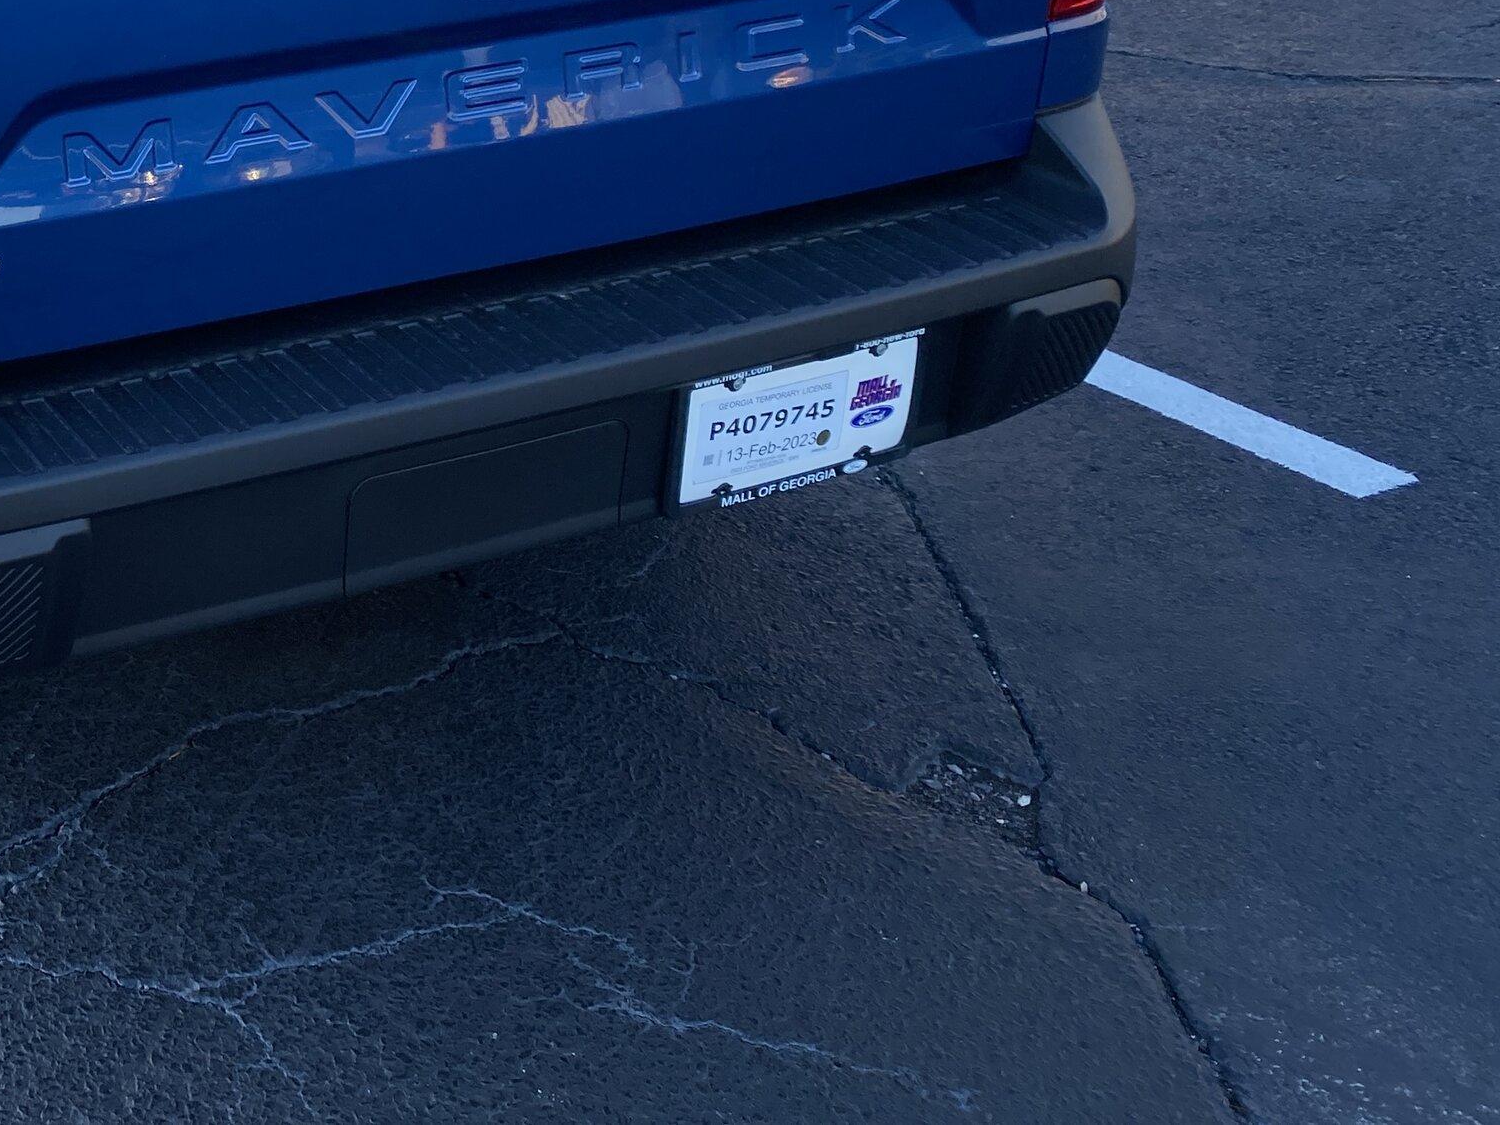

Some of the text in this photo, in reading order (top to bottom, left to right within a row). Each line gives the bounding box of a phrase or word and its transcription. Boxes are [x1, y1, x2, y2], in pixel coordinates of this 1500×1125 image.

[718, 382, 833, 411] GEORGIA TEMPORARY LICENSE
[709, 398, 836, 441] P4079745
[726, 431, 817, 463] 13-Feb-2023
[720, 467, 837, 508] MALL OF GEORGIA
